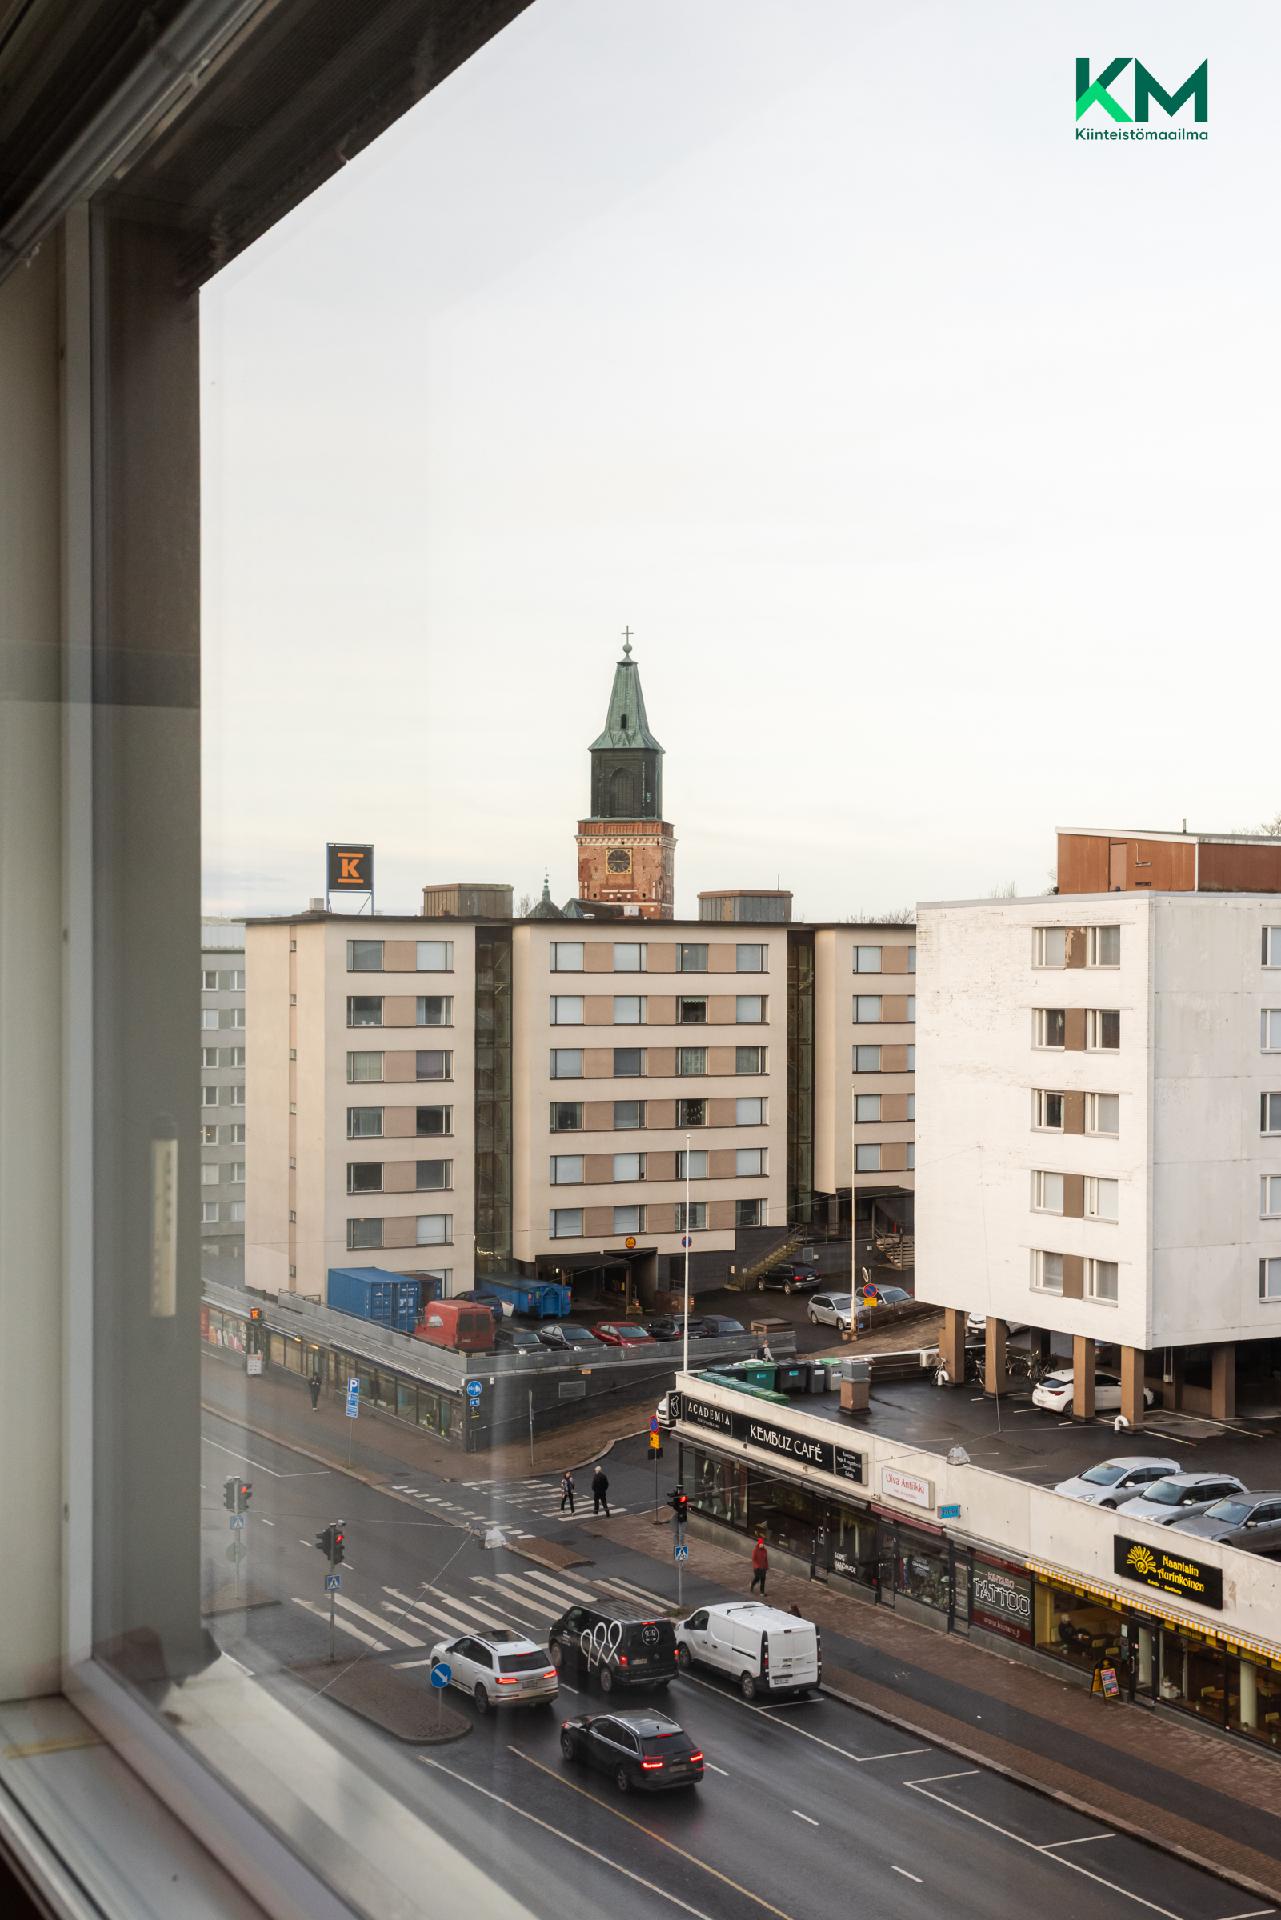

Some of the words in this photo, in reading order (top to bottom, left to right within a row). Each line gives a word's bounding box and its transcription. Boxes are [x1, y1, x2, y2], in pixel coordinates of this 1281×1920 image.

[341, 858, 361, 878] K
[688, 1402, 730, 1426] ACADEMIA
[750, 1424, 792, 1451] KEMBUZ
[794, 1440, 823, 1463] CAFÉ
[1162, 1554, 1200, 1577] Naantalin
[1157, 1568, 1205, 1592] Aurinkoinen
[973, 1577, 1031, 1616] TATTOO
